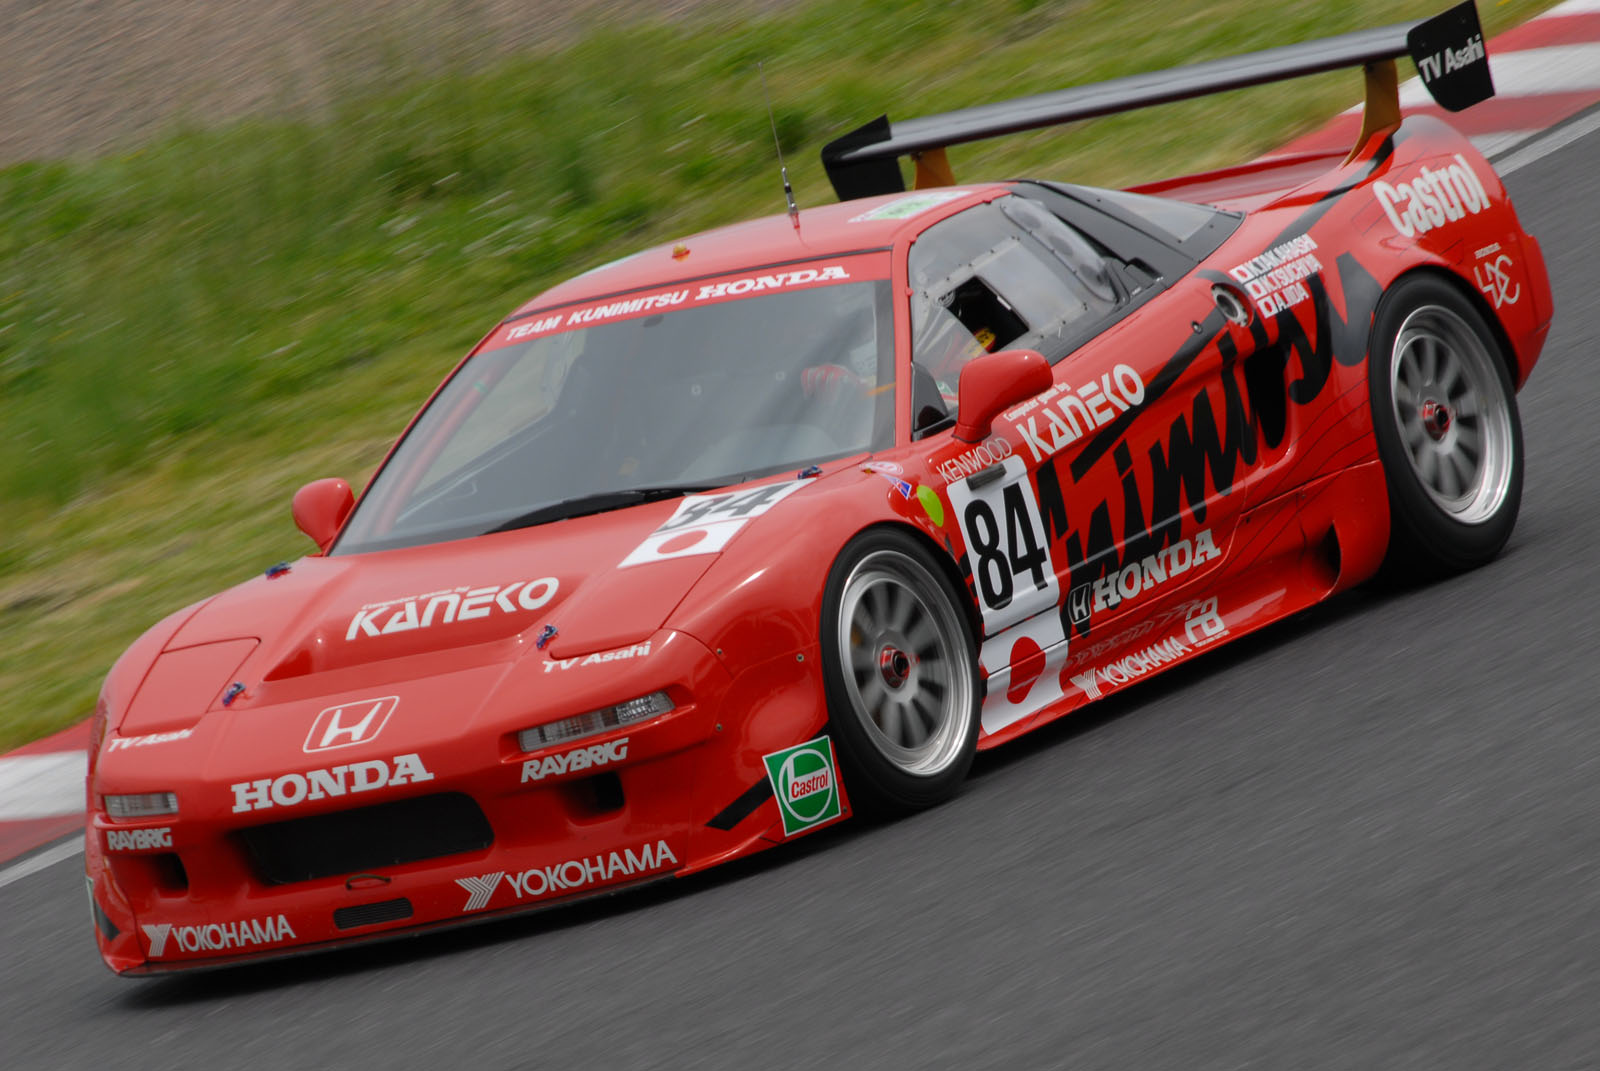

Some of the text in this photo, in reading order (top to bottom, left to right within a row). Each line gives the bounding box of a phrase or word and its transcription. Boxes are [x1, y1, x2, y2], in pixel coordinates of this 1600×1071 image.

[1418, 34, 1486, 84] TV Asahi
[1373, 153, 1492, 238] Castrol
[505, 265, 850, 341] TEAM KUNIMITSU HONDA
[1016, 363, 1145, 463] KANEKO
[935, 436, 1013, 485] KENWOOD
[964, 482, 1048, 612] 84
[1093, 528, 1222, 612] HONDA
[345, 577, 560, 641] KANEKO
[542, 641, 651, 674] TV Asahi
[1096, 635, 1193, 687] YOKOHAMA
[108, 736, 136, 752] TV
[520, 737, 630, 783] RAYBRIG
[231, 753, 434, 814] HONDA
[790, 766, 830, 800] Castrol
[107, 827, 173, 851] RAYBRIG
[505, 840, 678, 899] YOKOHAMA
[172, 914, 296, 953] YOKOHAMA
